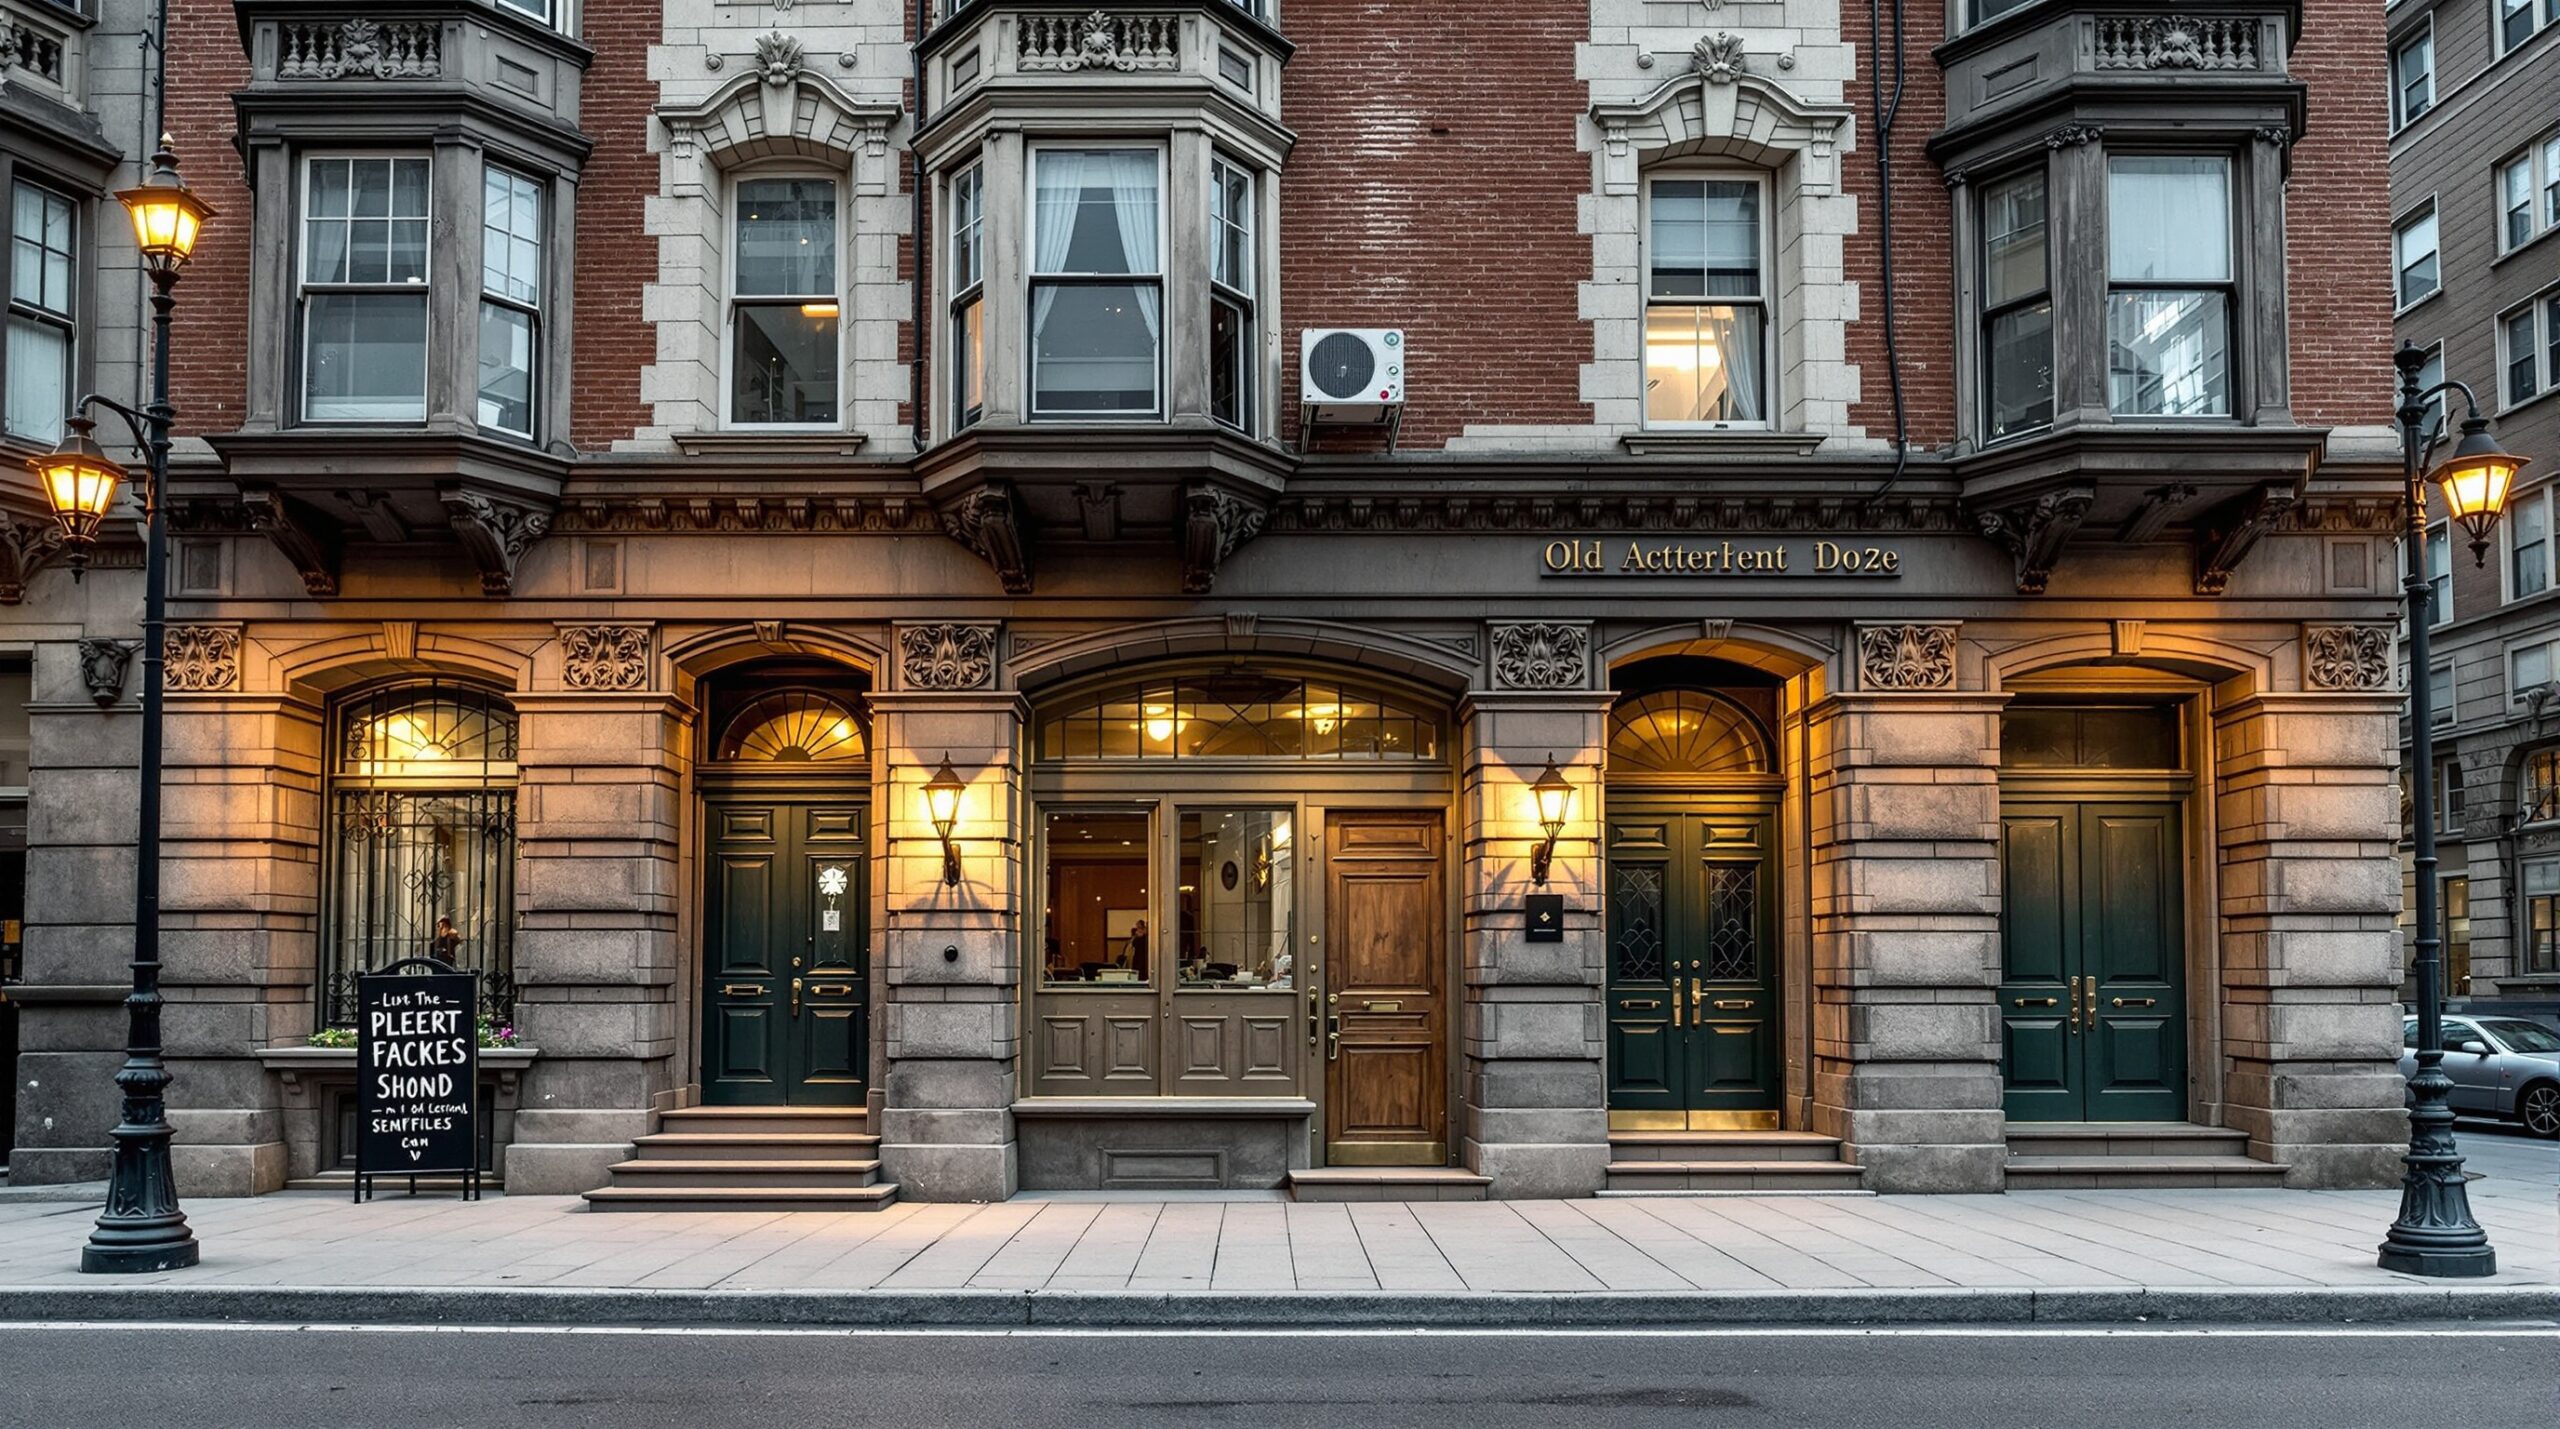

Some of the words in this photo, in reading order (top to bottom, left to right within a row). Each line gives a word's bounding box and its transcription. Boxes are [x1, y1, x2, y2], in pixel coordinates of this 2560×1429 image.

[1545, 540, 1604, 570] Old
[1814, 541, 1899, 570] Doze
[371, 1010, 463, 1037] PLEERT
[373, 1037, 467, 1068] FACKES
[377, 1073, 453, 1099] SHOND
